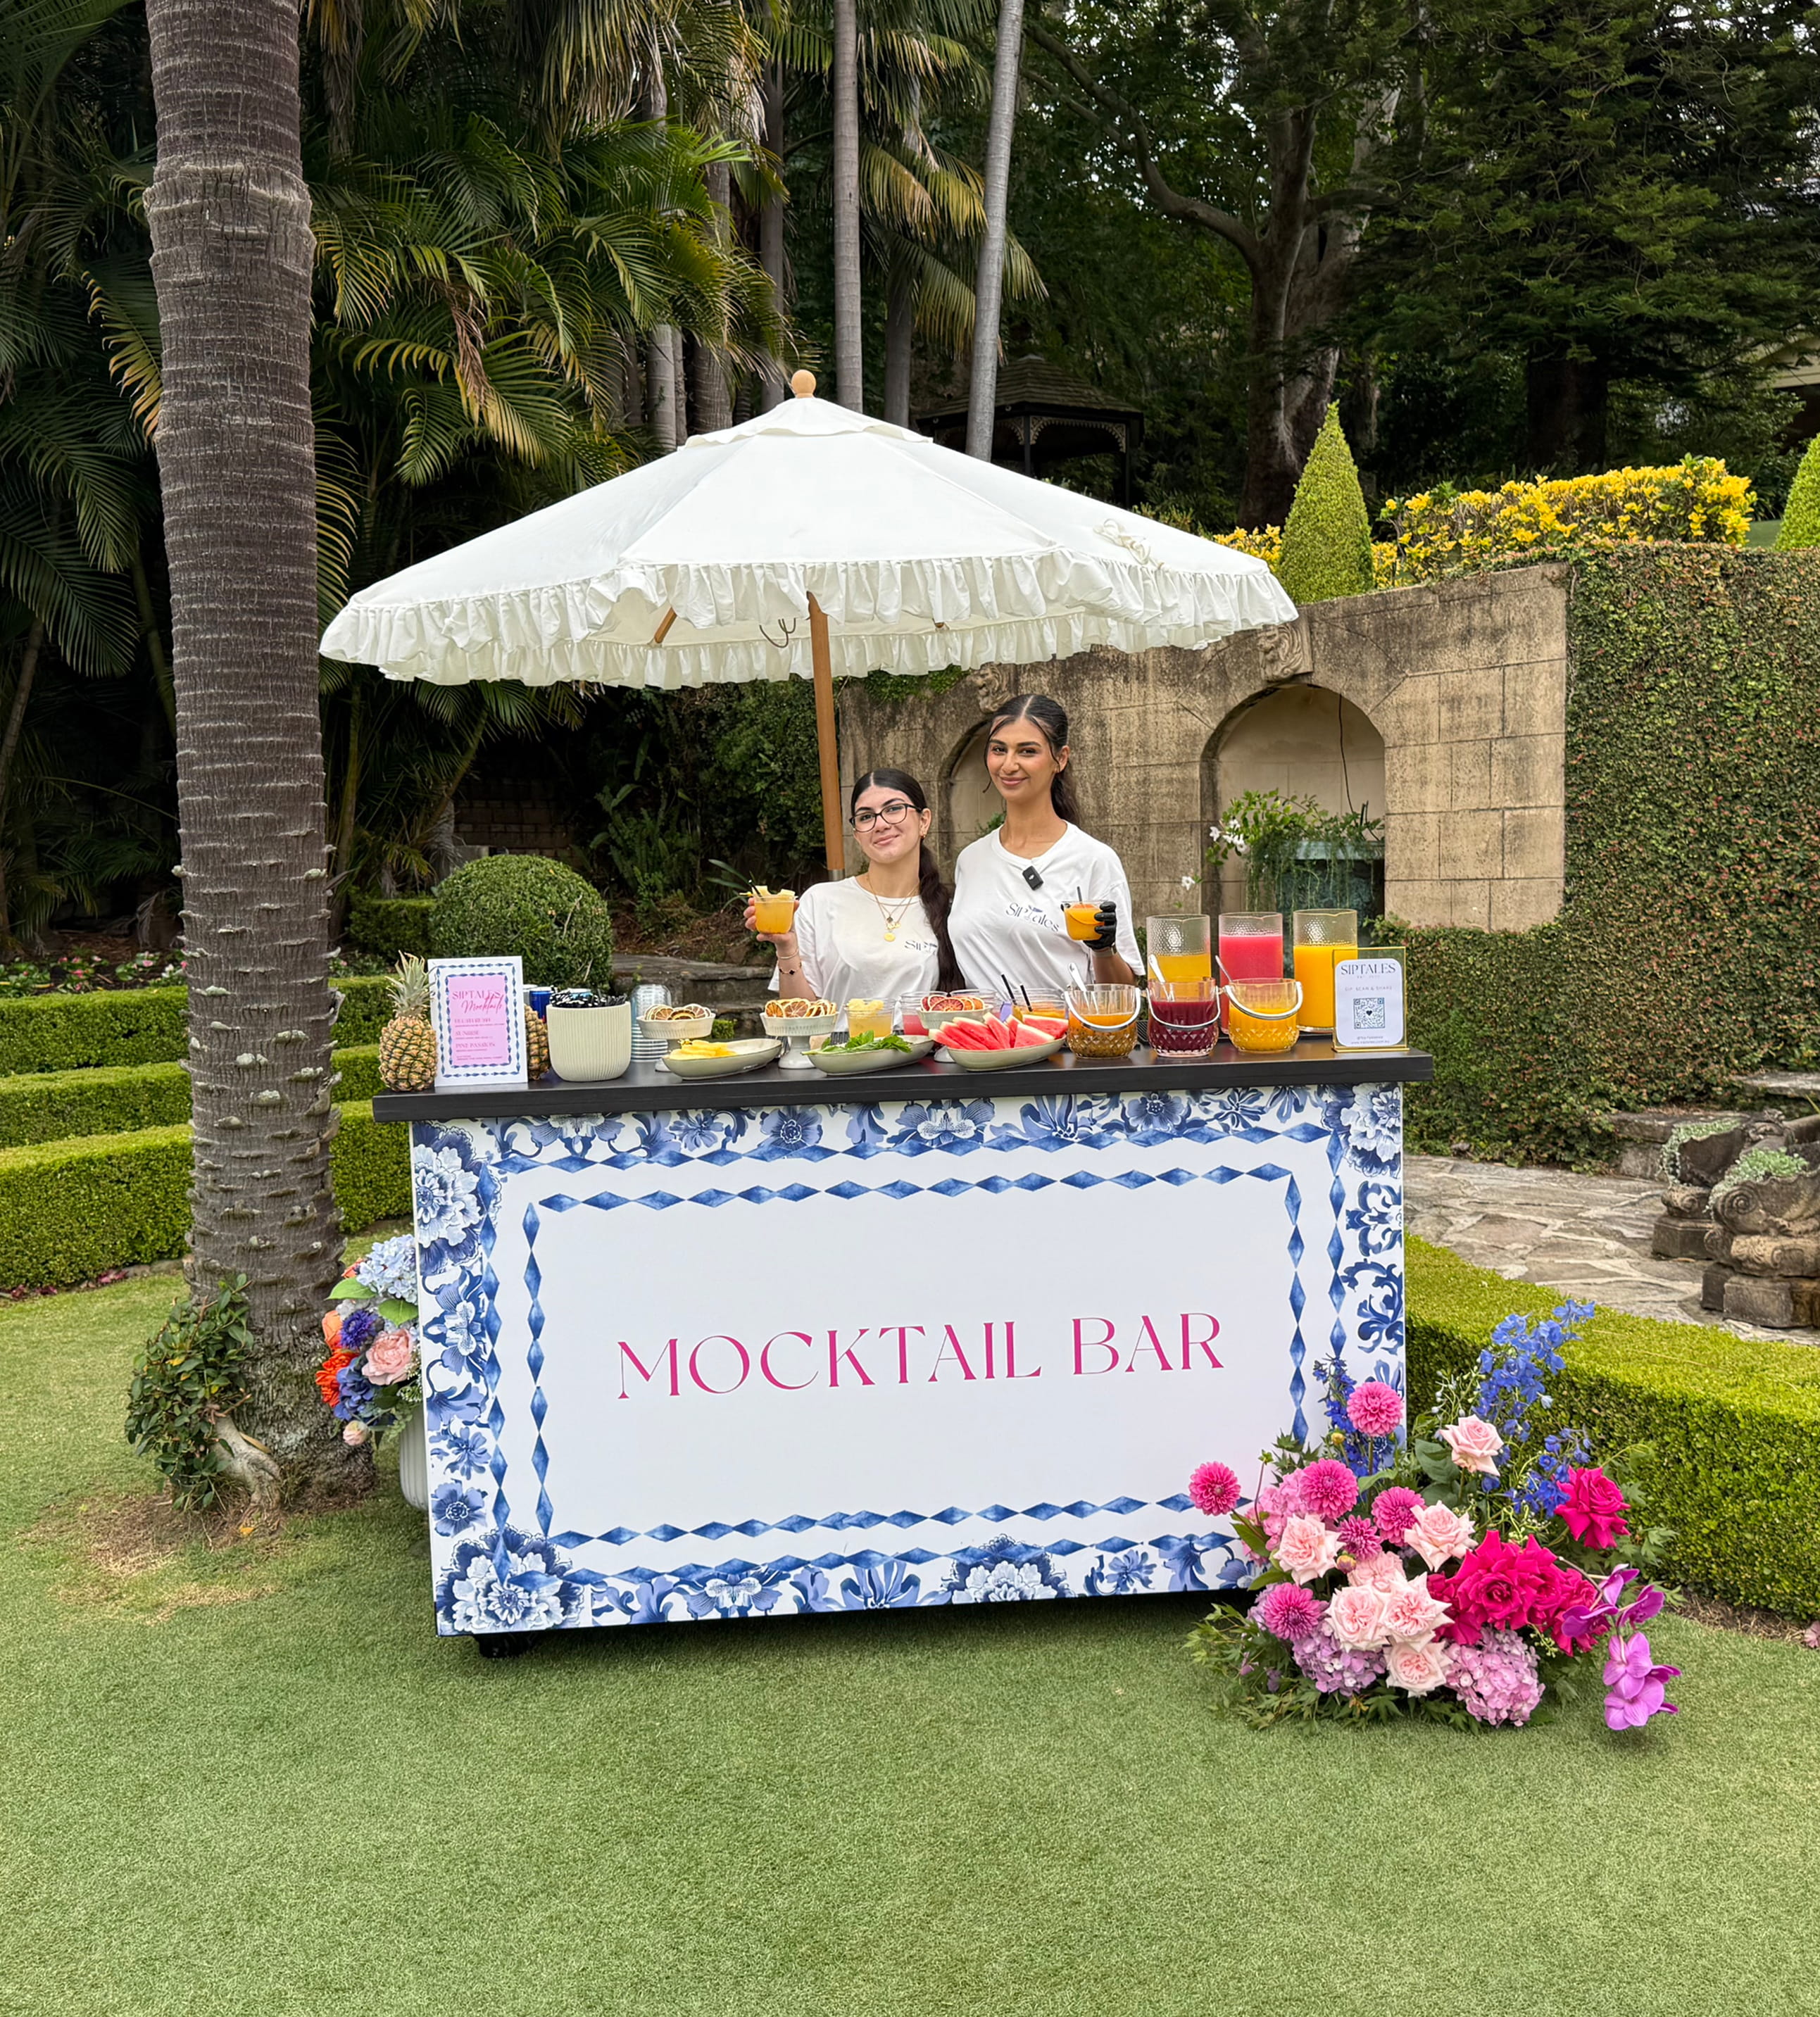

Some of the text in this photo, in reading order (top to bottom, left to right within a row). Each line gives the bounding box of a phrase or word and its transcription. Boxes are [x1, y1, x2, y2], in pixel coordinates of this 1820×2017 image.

[1341, 963, 1396, 975] SIPTALES
[617, 1312, 1224, 1400] MOCKTAIL BAR
